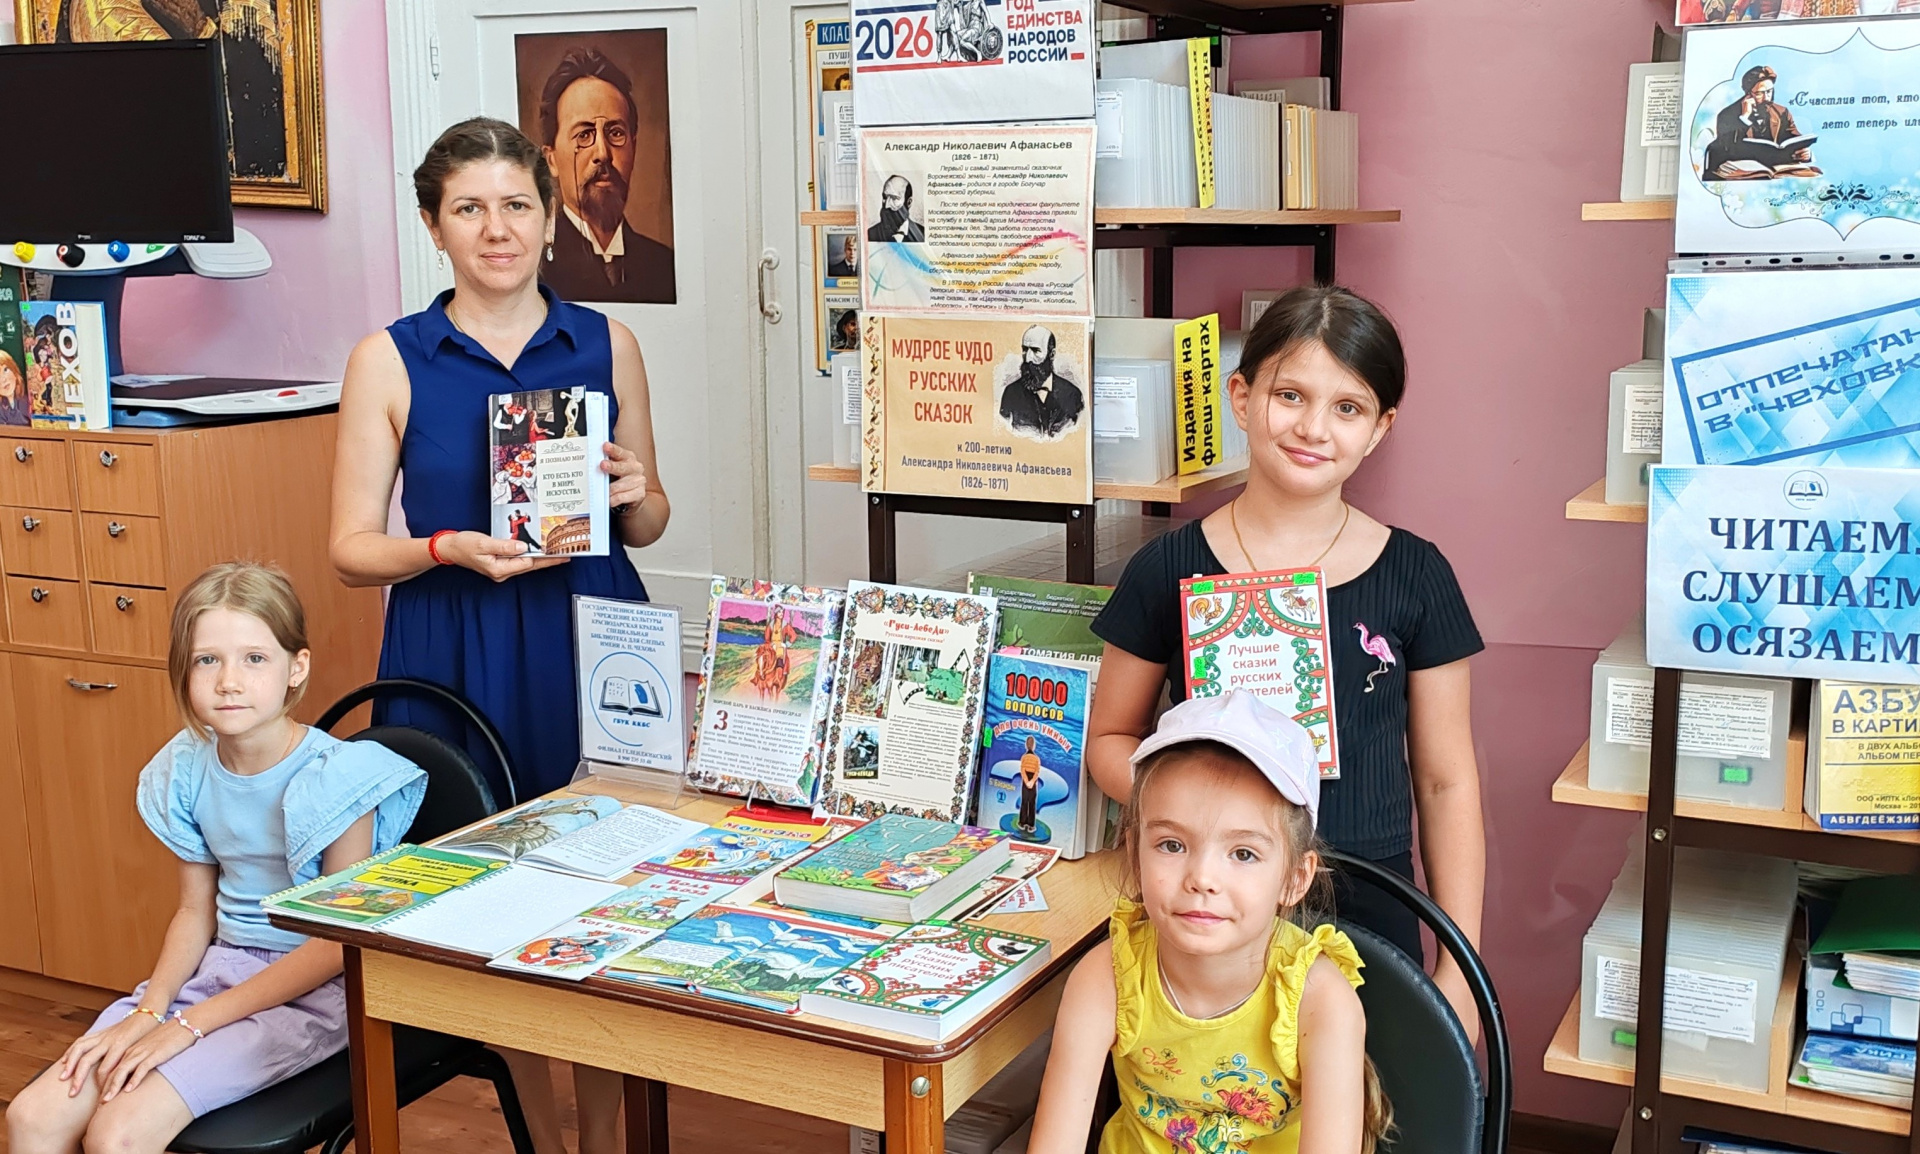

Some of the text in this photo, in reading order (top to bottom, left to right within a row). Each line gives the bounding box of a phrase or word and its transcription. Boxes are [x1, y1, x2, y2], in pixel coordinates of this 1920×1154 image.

[1006, 0, 1034, 12] ГОД
[1007, 10, 1082, 31] ЕДИНСТВА
[855, 15, 934, 61] 2026
[1008, 29, 1076, 46] НАРОДОВ
[1008, 47, 1068, 64] РОССИИ
[1789, 91, 1919, 106] «Счастлив тот, кто
[1191, 50, 1207, 196] Зарубежная
[1201, 51, 1214, 190] литература
[1822, 120, 1850, 129] лето
[1857, 119, 1898, 131] теперь
[885, 140, 1072, 153] Александр Николаевич Афанасьев
[952, 154, 971, 162] (1826
[979, 153, 999, 161] 1871)
[892, 338, 993, 365] МУДРОЕ ЧУДО
[56, 303, 85, 430] ЧЕХОВ
[909, 371, 977, 393] РУССКИХ
[1181, 337, 1196, 462] Издания на
[1200, 320, 1216, 466] флеш-картах
[914, 402, 972, 424] СКАЗОК
[1704, 413, 1734, 434] В
[957, 442, 1012, 455] к 200-летию
[901, 455, 1071, 476] Александра Николаевича Афанасьева
[546, 489, 581, 497] ИСКУССТВА
[1682, 571, 1920, 609] СЛУШАЕМ
[1228, 643, 1280, 657] Лучшие
[1692, 623, 1920, 664] ОСЯЗАЕМ
[1233, 659, 1276, 669] сказки
[1231, 672, 1281, 686] русских
[1006, 672, 1068, 707] 10000
[1225, 682, 1293, 696] пателей
[1005, 699, 1063, 721] вопросов
[1832, 718, 1920, 733] В КАРТИ
[1858, 752, 1900, 760] АЛЬБОМ
[617, 926, 650, 934] лиса
[914, 954, 957, 967] сказки
[917, 947, 968, 962] Лучшие
[888, 963, 956, 980] писателей
[901, 958, 953, 973] русских
[1815, 990, 1825, 1013] 100
